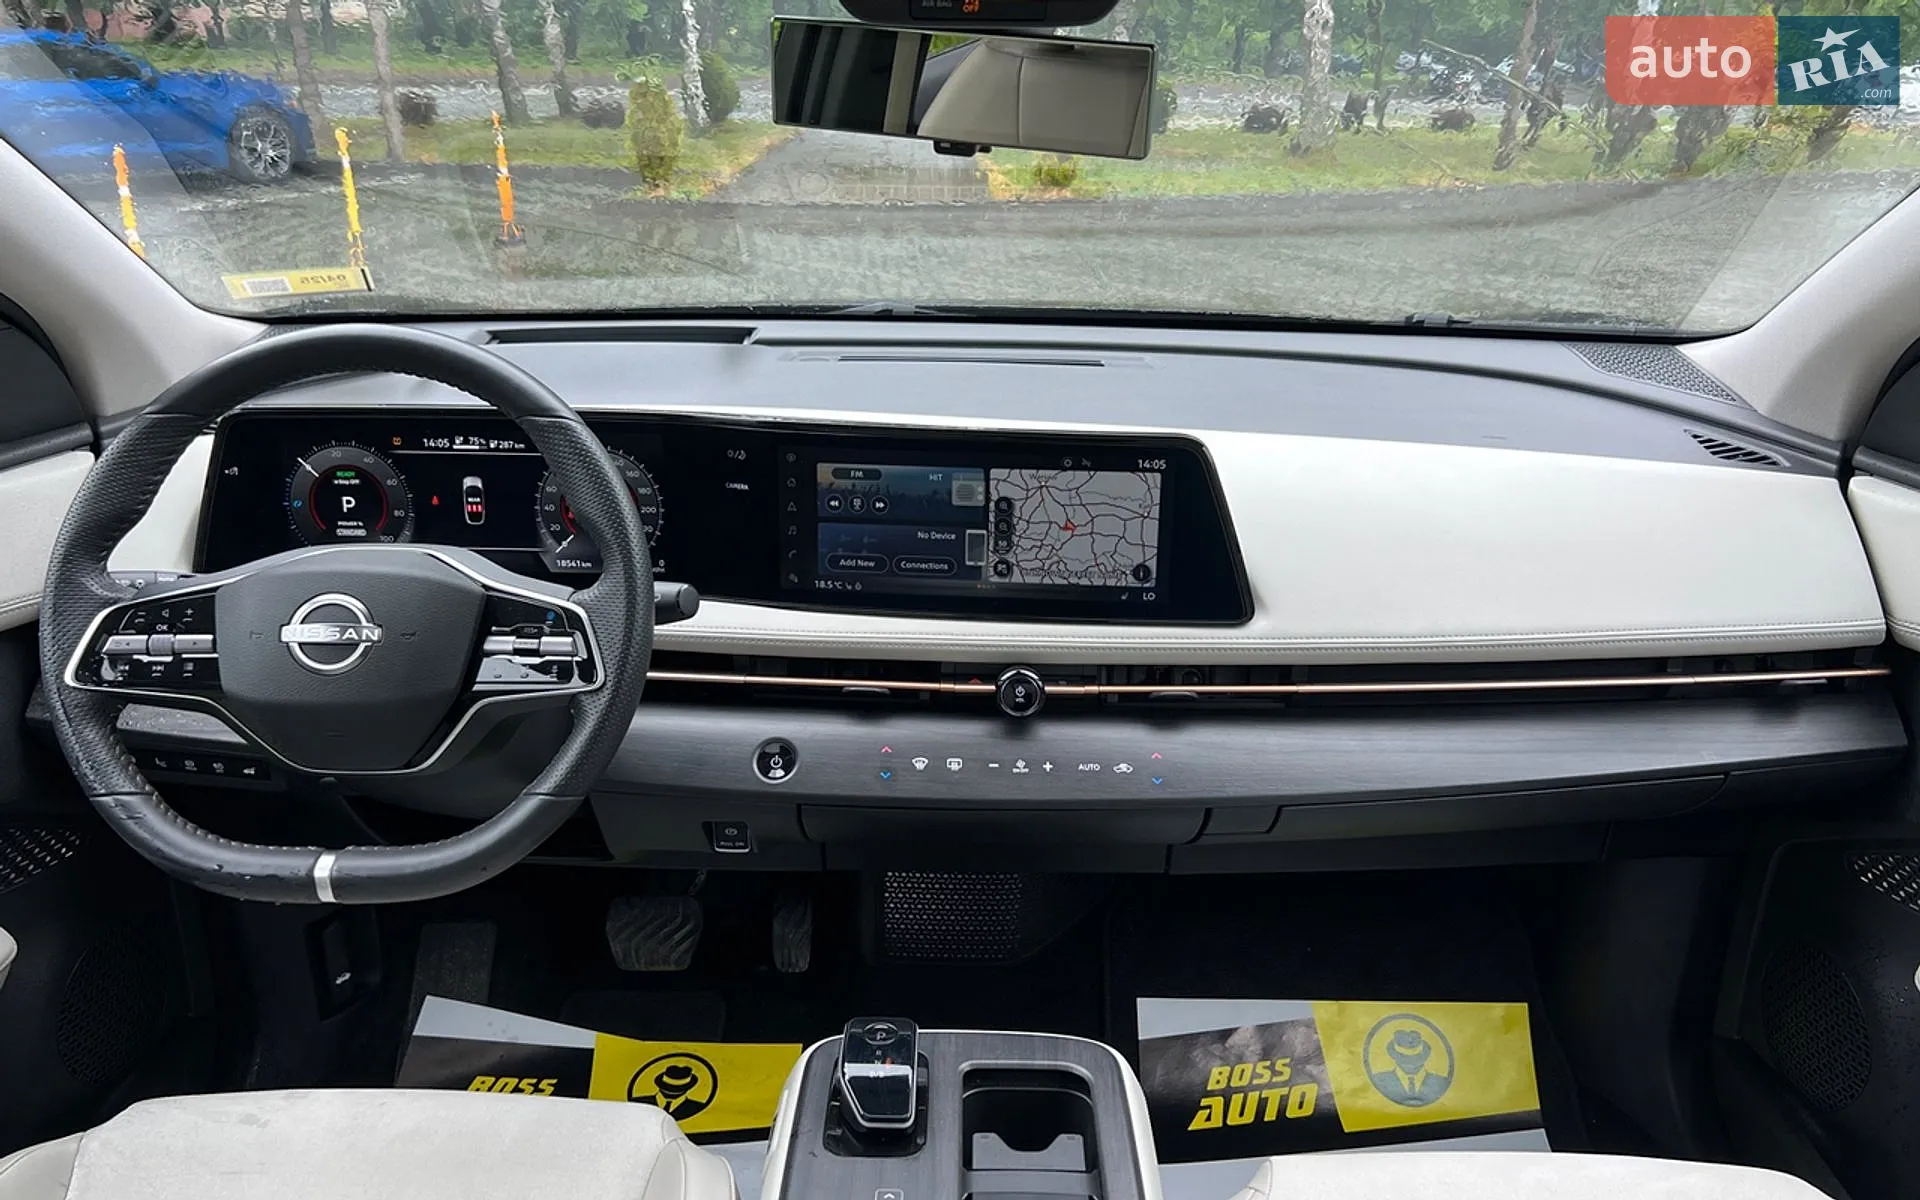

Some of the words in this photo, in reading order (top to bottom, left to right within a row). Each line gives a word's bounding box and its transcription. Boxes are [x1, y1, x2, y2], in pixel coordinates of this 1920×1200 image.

[422, 438, 450, 448] 14:05
[499, 440, 514, 450] 287
[1137, 459, 1166, 470] 14:05
[850, 470, 865, 478] FM
[725, 482, 749, 490] CAMERA
[341, 496, 356, 512] P
[544, 503, 555, 512] 40
[550, 523, 561, 531] 20
[917, 531, 929, 539] No
[930, 531, 956, 541] Device
[556, 559, 581, 568] 18541
[839, 558, 855, 567] Add
[857, 559, 875, 567] New
[900, 560, 949, 570] Connections
[1142, 592, 1156, 601] LO
[283, 626, 380, 642] NISSAN
[1077, 763, 1101, 771] AUTO
[876, 1032, 886, 1040] P
[1206, 1057, 1292, 1091] BOSS
[467, 1075, 559, 1095] BOSS
[1187, 1083, 1319, 1131] AUTO
